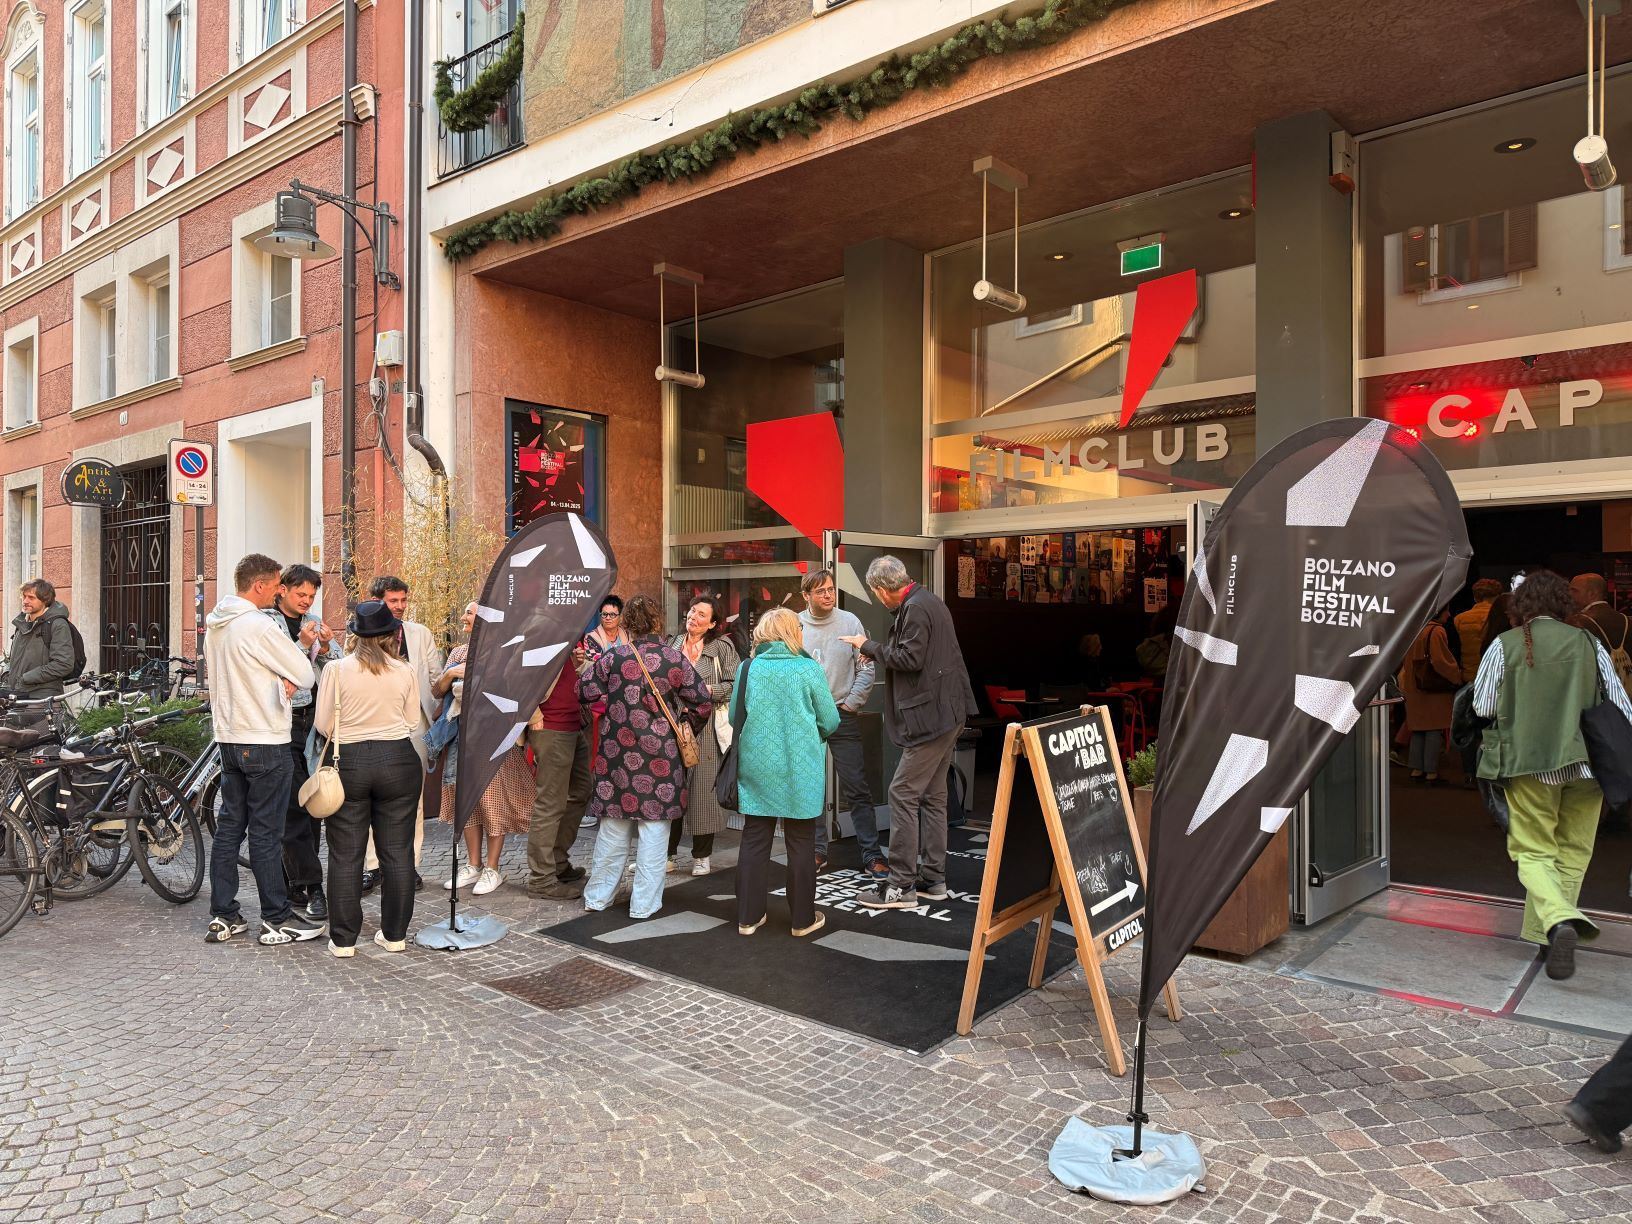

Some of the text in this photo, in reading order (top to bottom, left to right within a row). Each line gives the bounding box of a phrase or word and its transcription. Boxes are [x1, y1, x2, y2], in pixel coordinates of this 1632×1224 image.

[1427, 379, 1603, 438] CAP
[969, 423, 1229, 487] FILMCLUB
[74, 464, 111, 493] Antik
[98, 478, 107, 488] &
[92, 486, 112, 495] Art
[1304, 557, 1396, 578] BOLZANO
[548, 582, 570, 590] FILM
[549, 574, 591, 583] BOLZANO
[1226, 554, 1238, 615] FILMCLUB
[1303, 573, 1346, 592] FILM
[548, 589, 591, 598] FESTIVAL
[548, 597, 578, 605] BOZEN
[1301, 590, 1395, 614] FESTIVAL
[1300, 607, 1363, 628] BOZEN
[1048, 722, 1103, 756] CAPITOL
[1080, 744, 1107, 770] BAR
[1108, 918, 1143, 950] CAPITOL
